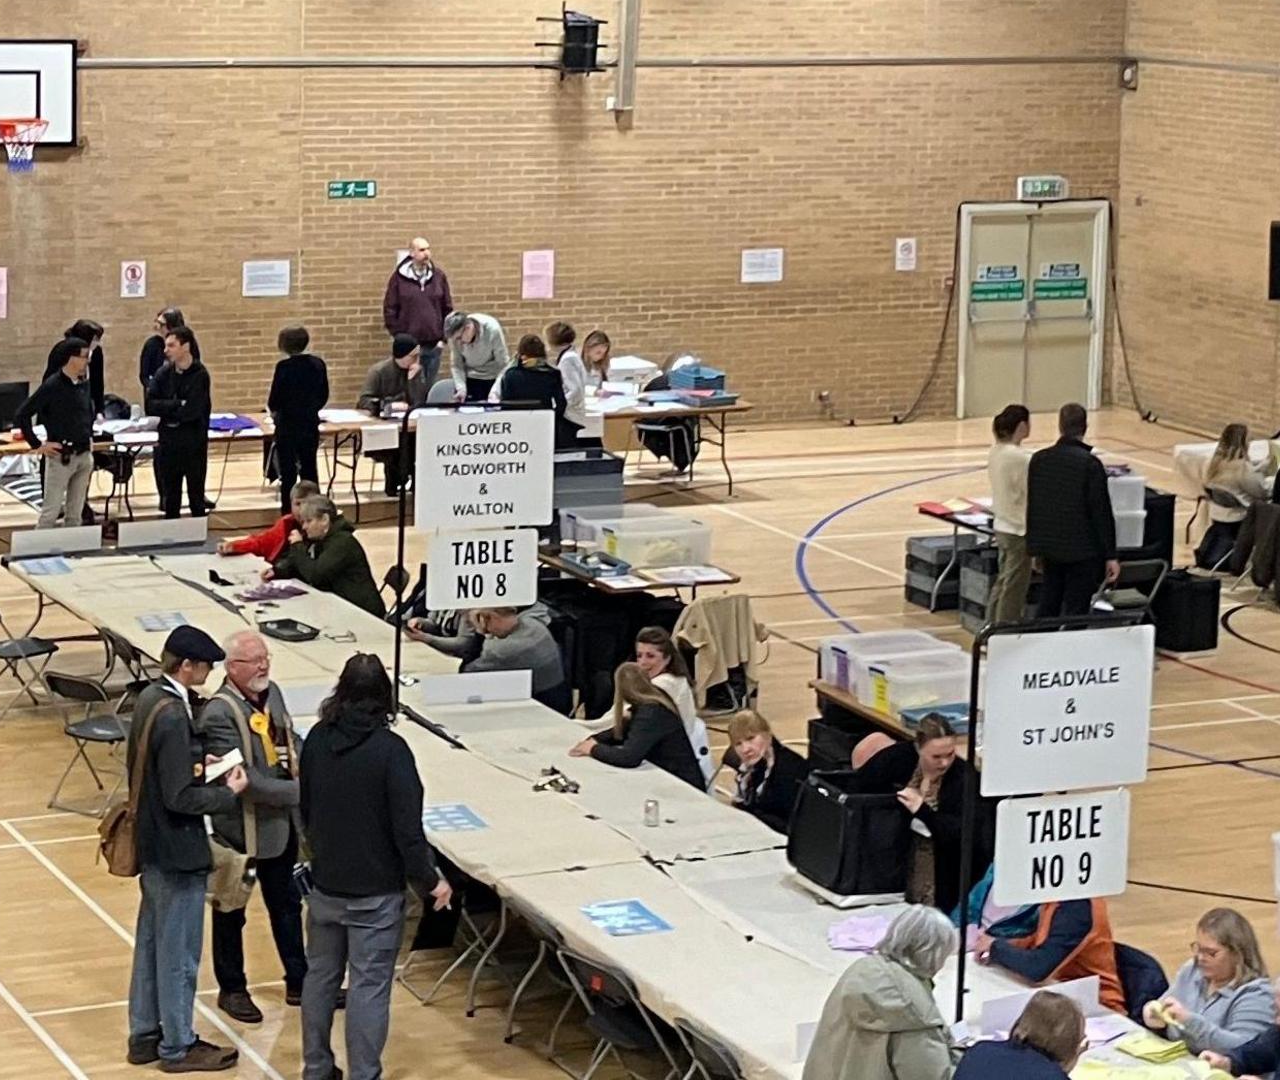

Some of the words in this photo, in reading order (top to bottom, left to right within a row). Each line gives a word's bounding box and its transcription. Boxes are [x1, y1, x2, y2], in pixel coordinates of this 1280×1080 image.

[458, 422, 511, 436] LOWER
[436, 441, 533, 457] KINGSWOOD,
[442, 462, 526, 476] TADWORTH
[478, 482, 488, 496] &
[452, 502, 514, 517] WALTON
[451, 539, 514, 566] TABLE
[456, 574, 484, 599] NO
[495, 572, 507, 597] 8
[1022, 666, 1120, 690] MEADVALE
[1064, 697, 1077, 715] &
[1022, 728, 1046, 746] ST
[1049, 721, 1115, 744] JOHN'S
[1026, 805, 1103, 844] TABLE
[1031, 853, 1064, 890] NO
[1077, 851, 1092, 885] 9
